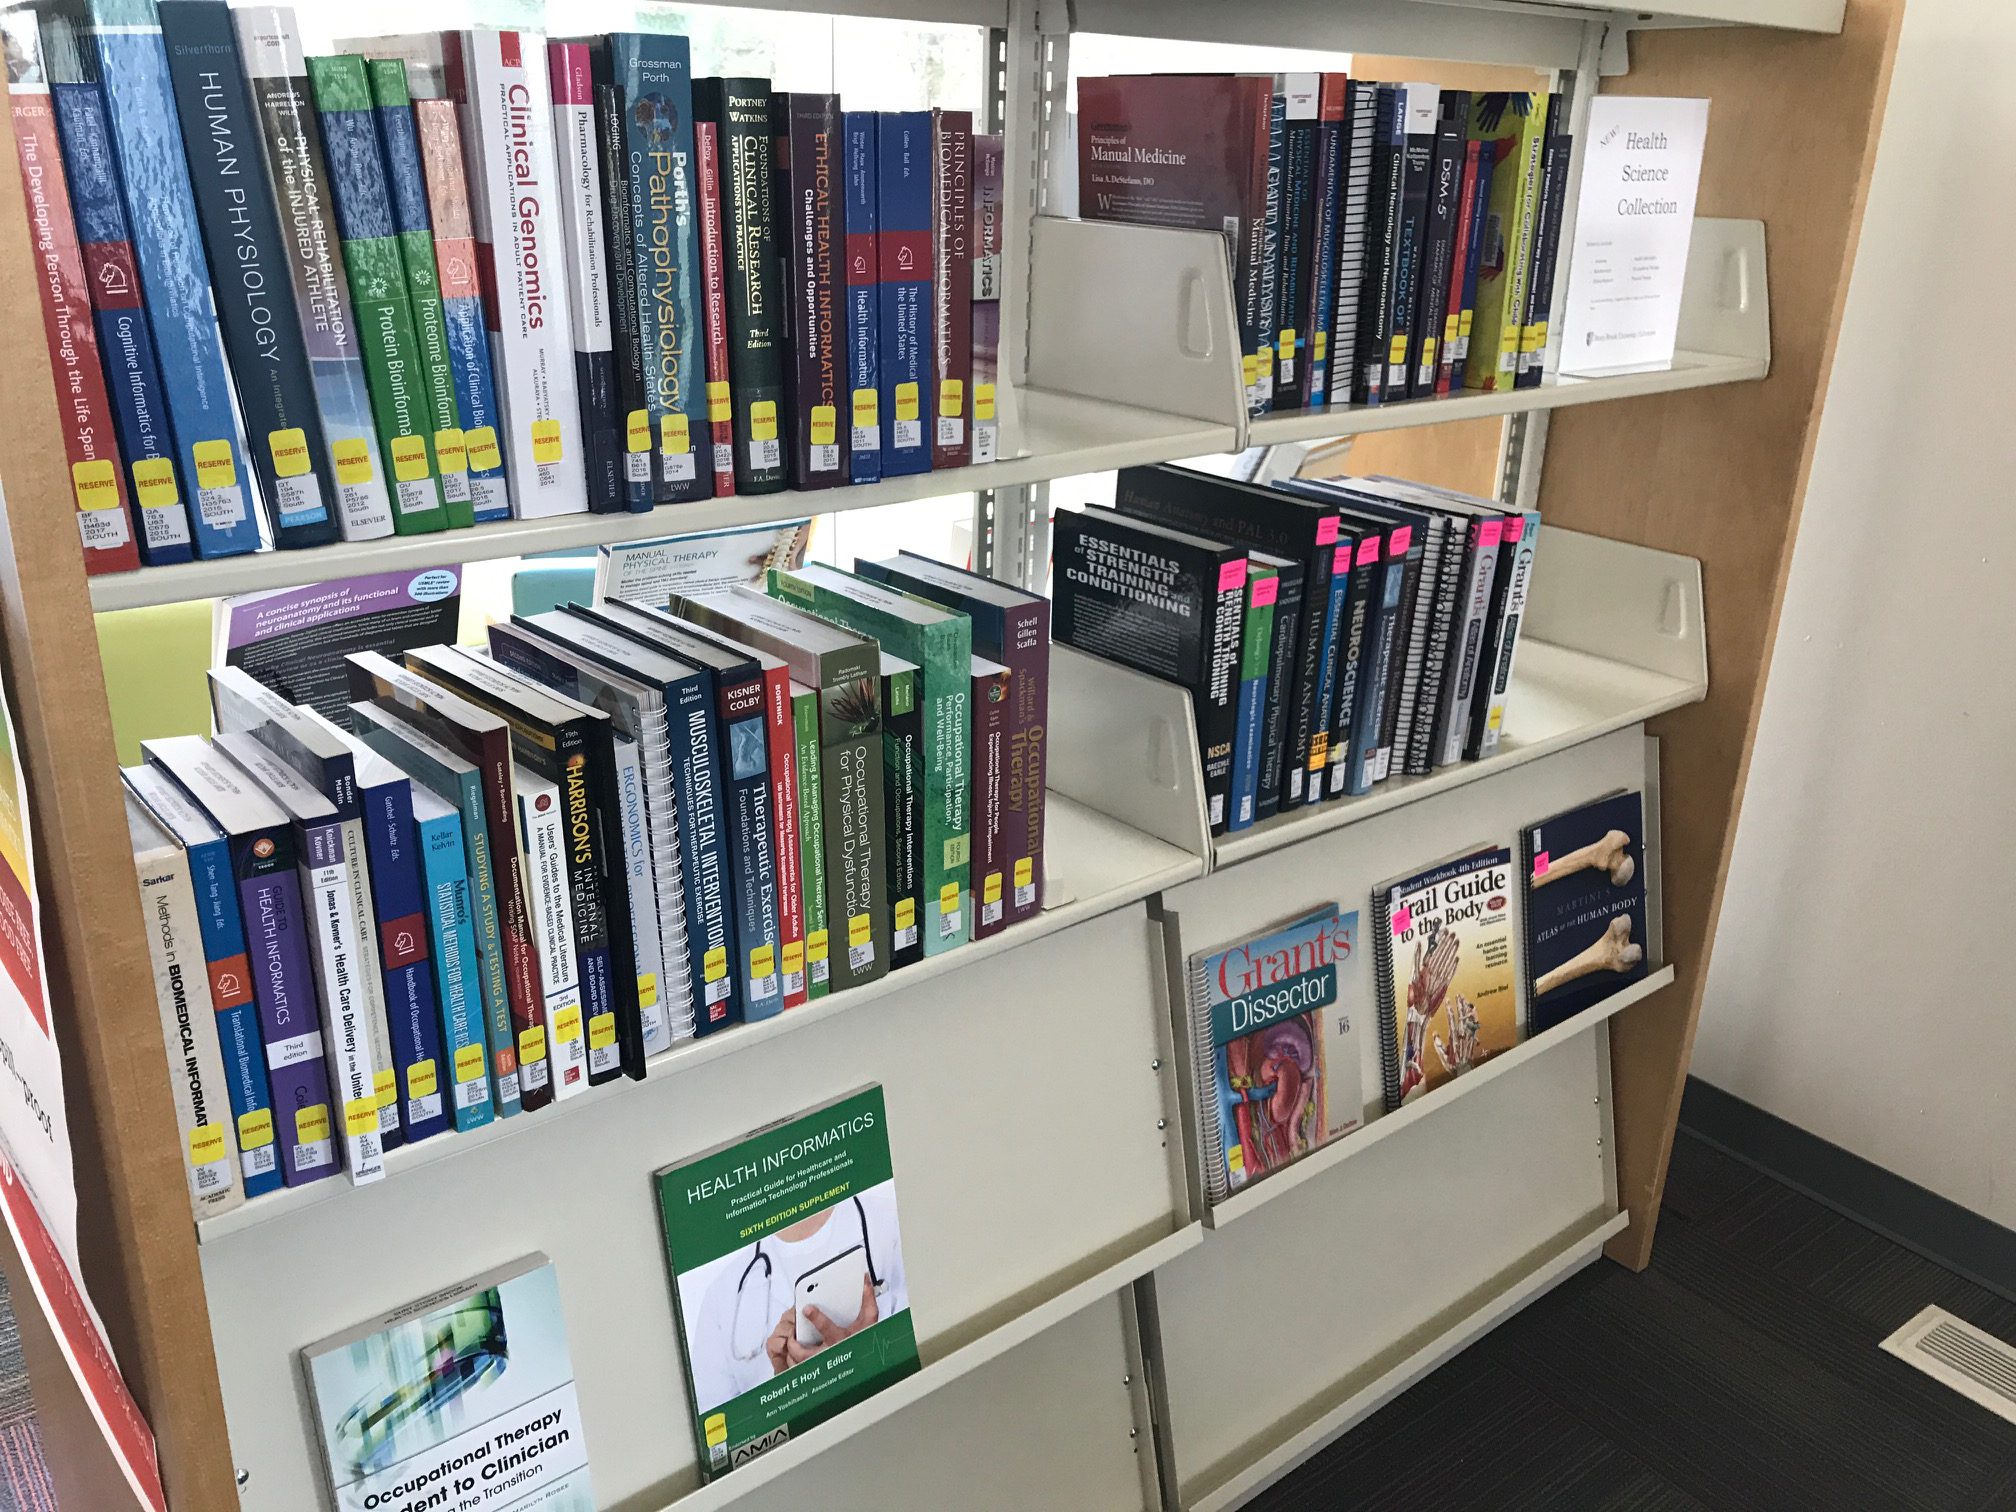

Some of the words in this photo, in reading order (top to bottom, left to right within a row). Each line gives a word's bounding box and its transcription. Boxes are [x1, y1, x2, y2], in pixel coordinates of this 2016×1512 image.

[504, 58, 521, 66] ACP
[575, 67, 583, 100] Gladson
[629, 58, 682, 69] Grossman
[642, 72, 670, 82] Porth
[729, 96, 767, 107] PORTNEY
[729, 111, 768, 122] WATKINS
[1395, 102, 1403, 135] LANGE
[22, 134, 37, 161] The
[278, 137, 293, 154] of
[508, 84, 537, 186] Clinical
[578, 111, 592, 192] Pharmacology
[1091, 146, 1132, 163] Manual
[1134, 148, 1186, 165] Medicine
[1626, 132, 1668, 150] Health
[280, 161, 294, 185] the
[631, 151, 643, 227] Concepts
[672, 151, 690, 227] Porth's
[744, 136, 758, 220] CLINICAL
[758, 136, 770, 223] FOUNDATIONS
[815, 133, 830, 210] ETHICAL
[1391, 153, 1400, 190] Clinical
[1438, 159, 1452, 215] DSM-5
[1622, 165, 1669, 182] Science
[29, 166, 54, 251] Developing
[199, 72, 240, 176] HUMAN
[224, 188, 280, 361] PHYSIOLOGY
[288, 189, 313, 259] INJURED
[805, 189, 815, 253] Challenges
[1384, 192, 1397, 244] Neurology
[1618, 197, 1677, 216] Collection
[294, 136, 317, 214] PHYSICAL
[311, 219, 348, 346] REHABILITATION
[586, 209, 597, 270] Rehabilitation
[635, 234, 645, 250] of
[763, 227, 771, 242] OF
[817, 216, 831, 285] HEALTH
[1383, 246, 1391, 265] and
[45, 253, 65, 304] Person
[518, 196, 547, 330] Genomics
[638, 253, 651, 305] Altered
[649, 152, 683, 412] Pathophysiology
[748, 225, 763, 315] RESEARCH
[807, 255, 816, 278] and
[304, 264, 329, 331] ATHLETE
[591, 273, 601, 328] Professionals
[806, 281, 816, 358] Opportunities
[1376, 264, 1389, 340] Neuroanatomy
[55, 305, 77, 366] Through
[641, 306, 652, 361] Health
[819, 290, 834, 405] INFORMATICS
[68, 370, 83, 394] the
[118, 317, 138, 369] Cognitive
[129, 371, 151, 433] Informatics
[142, 434, 156, 452] for
[644, 367, 655, 412] States
[74, 398, 90, 423] Life
[78, 427, 96, 461] Span
[395, 453, 426, 464] RESERVE
[78, 479, 115, 490] RESERVE
[351, 515, 386, 527] ELSEVIER
[623, 558, 671, 570] PHYSICAL
[673, 550, 719, 563] THERAPY
[626, 549, 667, 561] MANUAL
[1074, 545, 1086, 555] of
[1086, 551, 1175, 586] STRENGTH
[1079, 534, 1180, 574] ESSENTIALS
[265, 604, 299, 618] concise
[300, 593, 339, 609] synopsis
[340, 588, 350, 597] of
[1067, 568, 1191, 617] CONDITIONING
[1087, 562, 1169, 596] TRAINING
[1171, 592, 1190, 603] and
[1473, 554, 1493, 618] Grant's
[1510, 548, 1532, 612] Grant's
[254, 626, 272, 637] and
[274, 617, 305, 632] clinical
[307, 604, 361, 627] applications
[256, 607, 322, 629] neuroanatomy
[323, 601, 339, 611] and
[341, 597, 352, 606] its
[354, 587, 399, 603] functional
[1017, 617, 1038, 629] Schell
[1016, 638, 1037, 650] Scaffa
[1017, 629, 1037, 639] Gillen
[1305, 611, 1321, 676] HUMAN
[1338, 600, 1366, 727] NEUROSCIENCE
[727, 684, 761, 700] KISNER
[730, 696, 760, 711] COLBY
[775, 684, 784, 726] BORTNICK
[1296, 682, 1311, 762] ANATOMY
[840, 750, 851, 772] for
[1009, 728, 1027, 813] Therapy
[1207, 742, 1231, 759] NSCA
[688, 709, 716, 850] MUSCULOSKELETAL
[840, 775, 855, 833] Physical
[855, 746, 871, 845] Occupational
[1027, 725, 1044, 855] Occupational
[566, 765, 592, 863] HARRISON'S
[753, 783, 770, 881] Therapeutic
[142, 874, 175, 887] Sarkar
[843, 835, 857, 917] Dysfunctio
[859, 848, 872, 909] Therapy
[1423, 869, 1457, 885] Workbook
[1458, 864, 1471, 874] 4th
[1472, 856, 1498, 870] Edition
[1445, 870, 1506, 905] Guide
[156, 895, 173, 949] Methods
[258, 888, 277, 939] HEALTH
[453, 879, 467, 924] Munro's
[701, 853, 725, 949] INTERVENTION
[760, 884, 774, 946] Exercise
[1401, 928, 1414, 944] to
[1418, 917, 1442, 935] the
[1445, 900, 1484, 926] Body
[1537, 924, 1559, 944] ATLAS
[1577, 906, 1609, 925] HUMAN
[1612, 897, 1638, 911] BODY
[165, 951, 176, 963] in
[1218, 917, 1351, 999] Grant's
[265, 940, 290, 1026] INFORMATICS
[1231, 973, 1329, 1032] Dissector
[168, 964, 194, 1055] BIOMEDICAL
[1339, 1019, 1350, 1035] 16
[283, 1050, 308, 1060] edition
[284, 1042, 304, 1051] Third
[687, 1162, 758, 1204] HEALTH
[762, 1112, 874, 1173] INFORMATICS
[730, 1189, 762, 1206] Practical
[764, 1178, 785, 1193] Guide
[786, 1173, 796, 1184] for
[797, 1158, 833, 1178] Healthcare
[834, 1150, 847, 1161] and
[725, 1198, 767, 1219] Information
[768, 1180, 808, 1202] Technology
[809, 1159, 854, 1183] Professionals
[739, 1221, 765, 1239] SIXTH
[765, 1206, 798, 1227] EDITION
[799, 1181, 851, 1211] SUPPLEMENT
[760, 1382, 790, 1405] Robert
[791, 1379, 799, 1389] E
[799, 1367, 821, 1386] Hoyt
[826, 1351, 853, 1370] Editor
[363, 1442, 492, 1510] Occupational
[495, 1408, 562, 1450] Therapy
[453, 1477, 475, 1494] to
[480, 1428, 570, 1480] Clinician
[734, 1428, 787, 1464] AMIA
[460, 1495, 482, 1512] the
[482, 1462, 543, 1501] Transition
